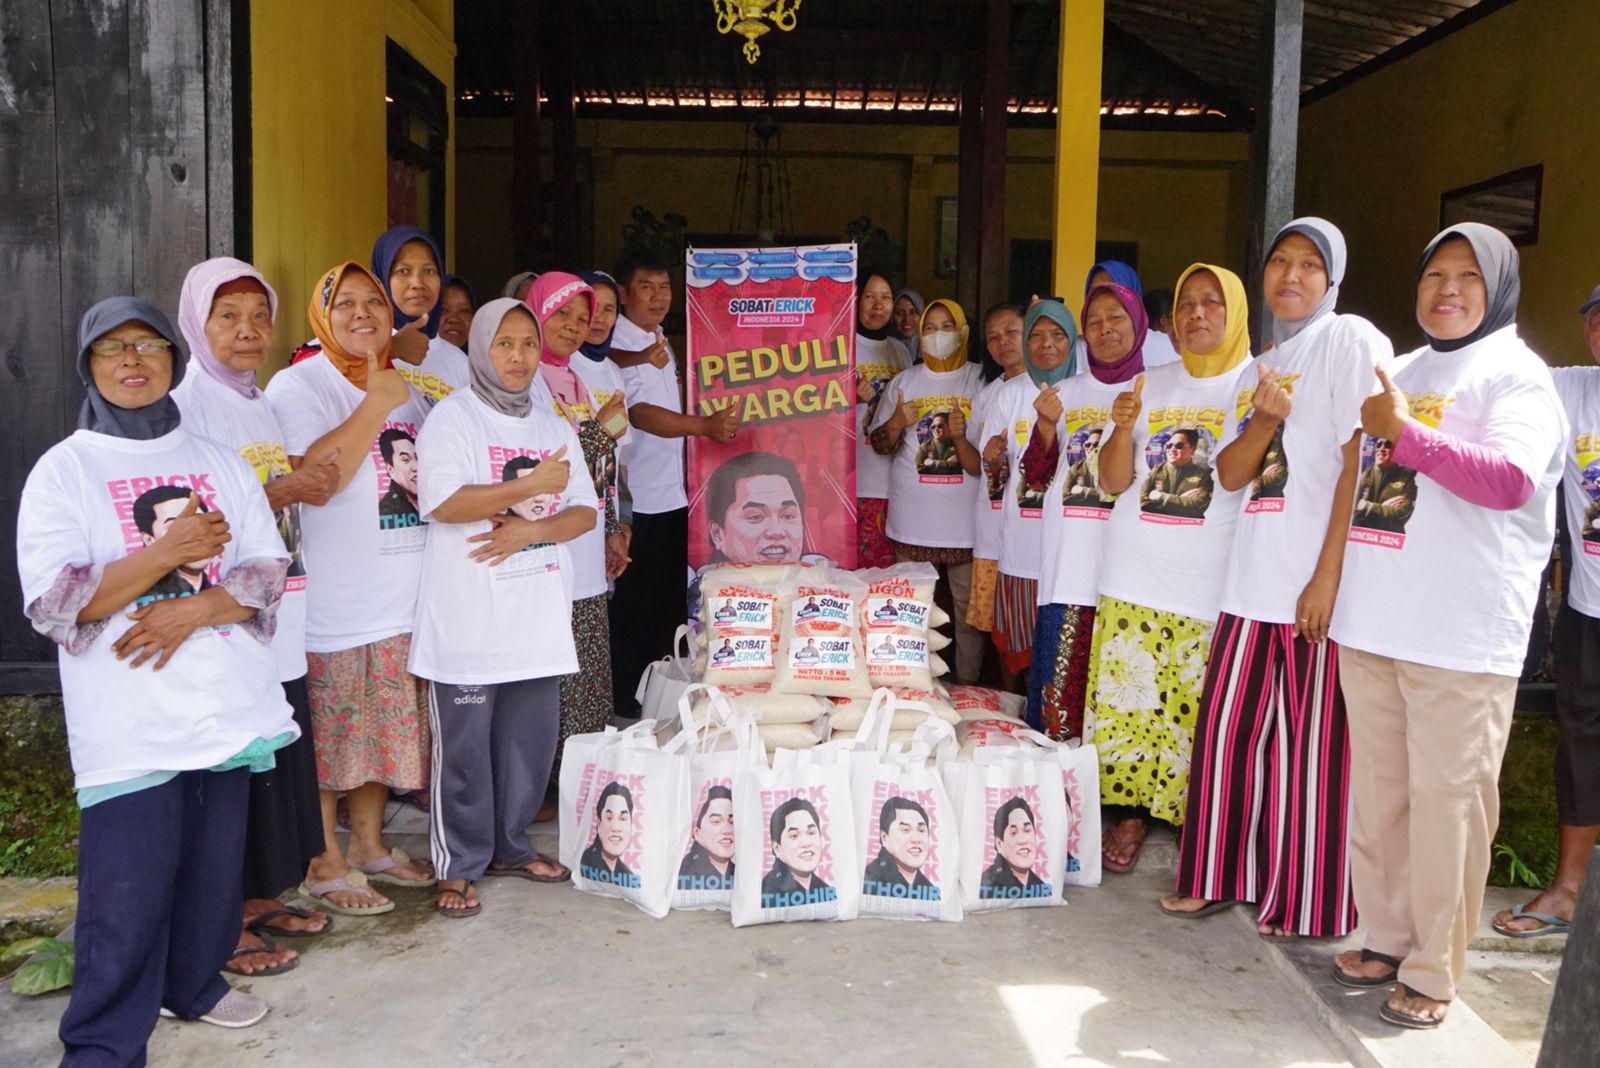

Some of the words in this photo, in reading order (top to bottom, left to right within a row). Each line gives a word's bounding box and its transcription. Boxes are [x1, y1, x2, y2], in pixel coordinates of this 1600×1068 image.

[729, 299, 773, 314] SOBAT
[774, 298, 815, 313] ERICK
[743, 315, 780, 324] INDONESIA
[781, 315, 800, 324] 2024
[699, 334, 849, 388] PEDULI
[380, 513, 419, 528] THO
[1379, 535, 1400, 546] 2024
[737, 601, 769, 612] SOBAT
[820, 598, 850, 612] SOBAT
[898, 602, 927, 616] SOBAT
[738, 612, 768, 623] ERICK
[821, 607, 849, 621] ERICK
[900, 613, 925, 626] ERICK
[735, 639, 767, 650] SOBAT
[819, 641, 850, 652] SOBAT
[896, 639, 926, 652] SOBAT
[737, 651, 767, 662] ERICK
[820, 652, 850, 664] ERICK
[897, 650, 926, 663] ERICK
[678, 875, 735, 890] THOH
[761, 886, 838, 908] THOHIR
[863, 880, 941, 901] THOHIR
[981, 883, 1053, 899] THOHIR
